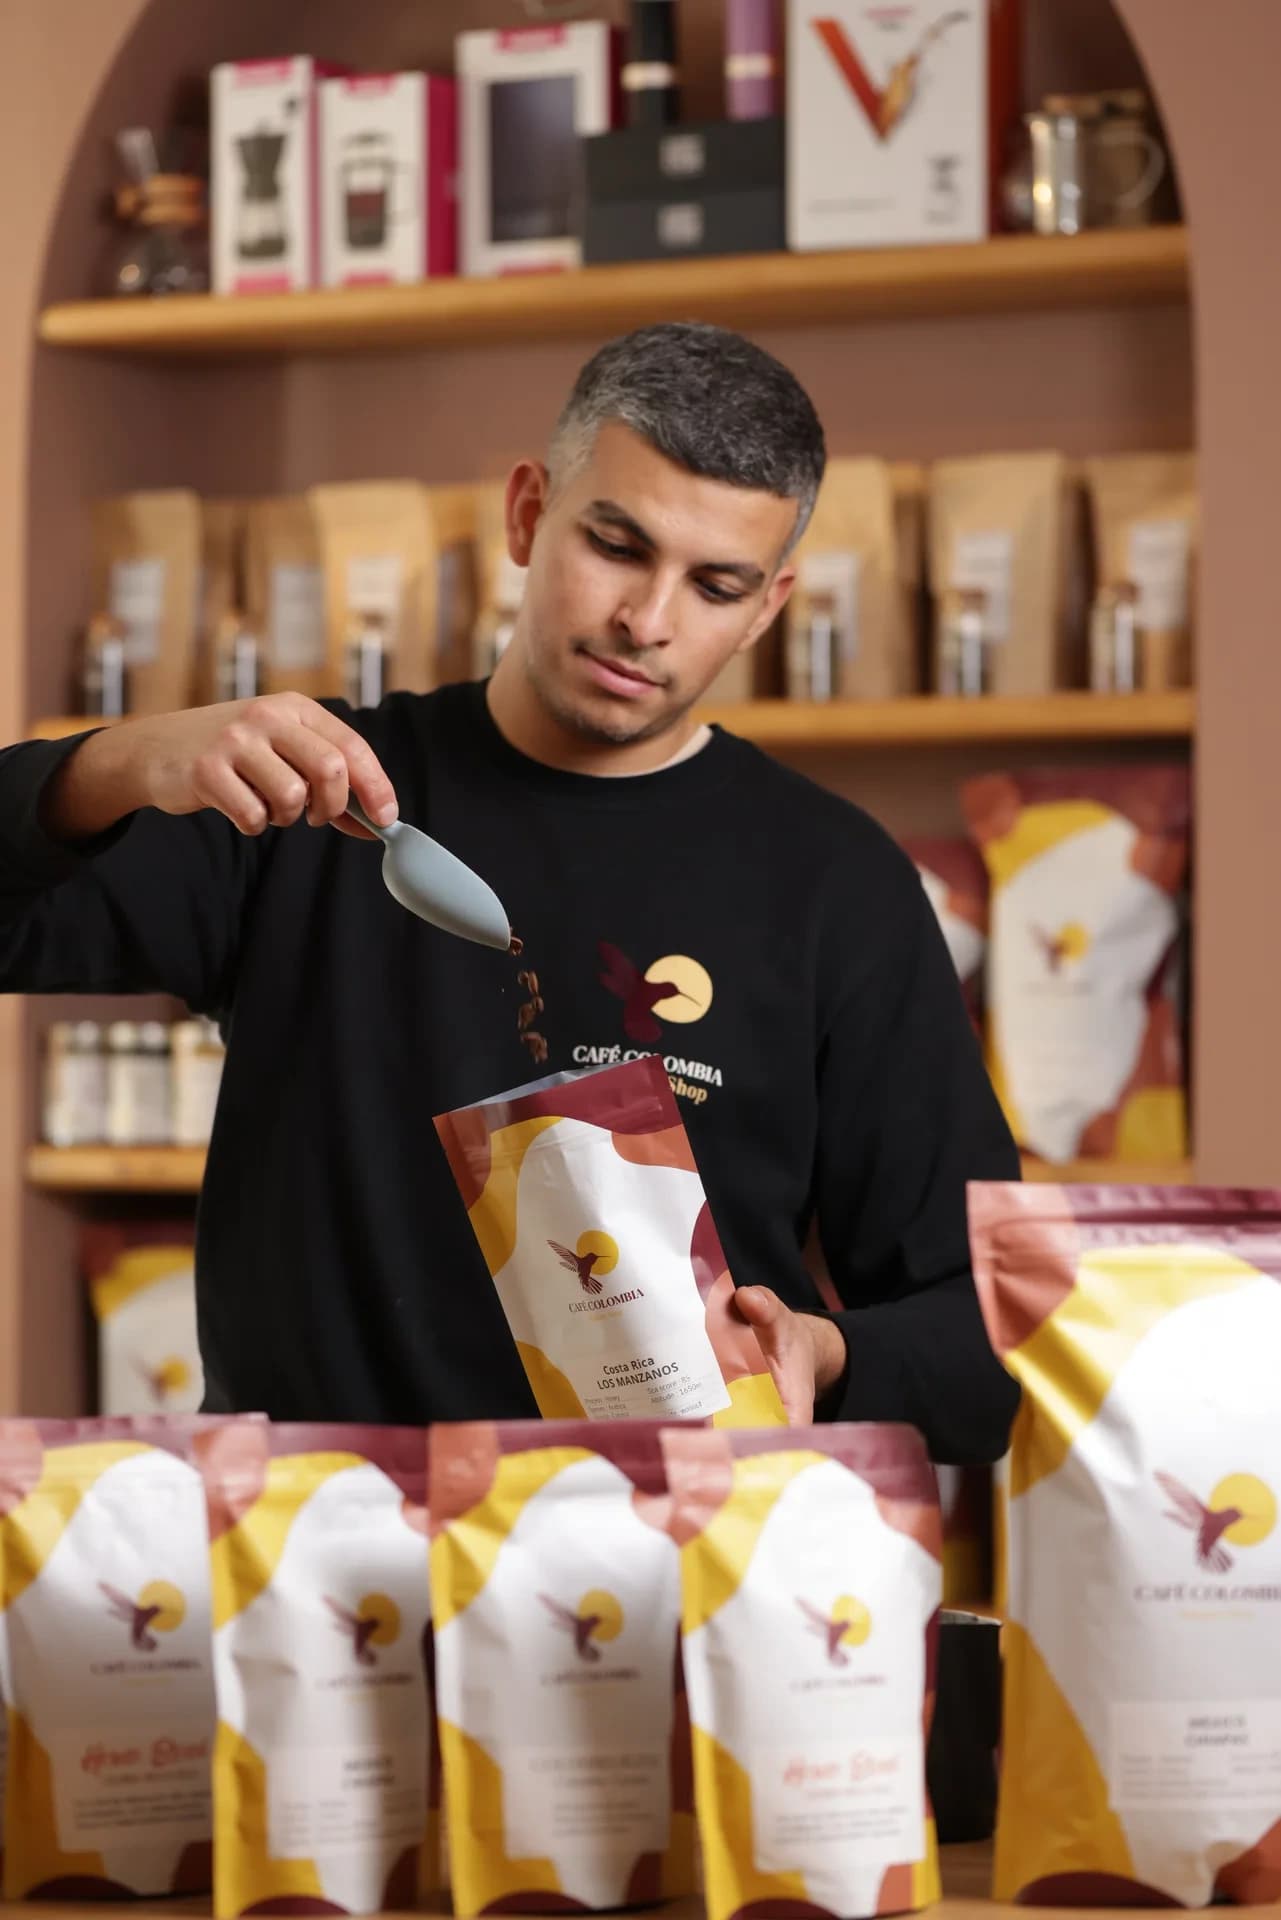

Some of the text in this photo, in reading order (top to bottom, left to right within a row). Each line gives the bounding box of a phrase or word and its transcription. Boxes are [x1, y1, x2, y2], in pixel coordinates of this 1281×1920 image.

[572, 1044, 723, 1086] CAFÉ COMBIA
[588, 1288, 645, 1311] COLOMBIA
[597, 1362, 679, 1390] LOS MANZANOS
[603, 1357, 655, 1376] Costa Rica
